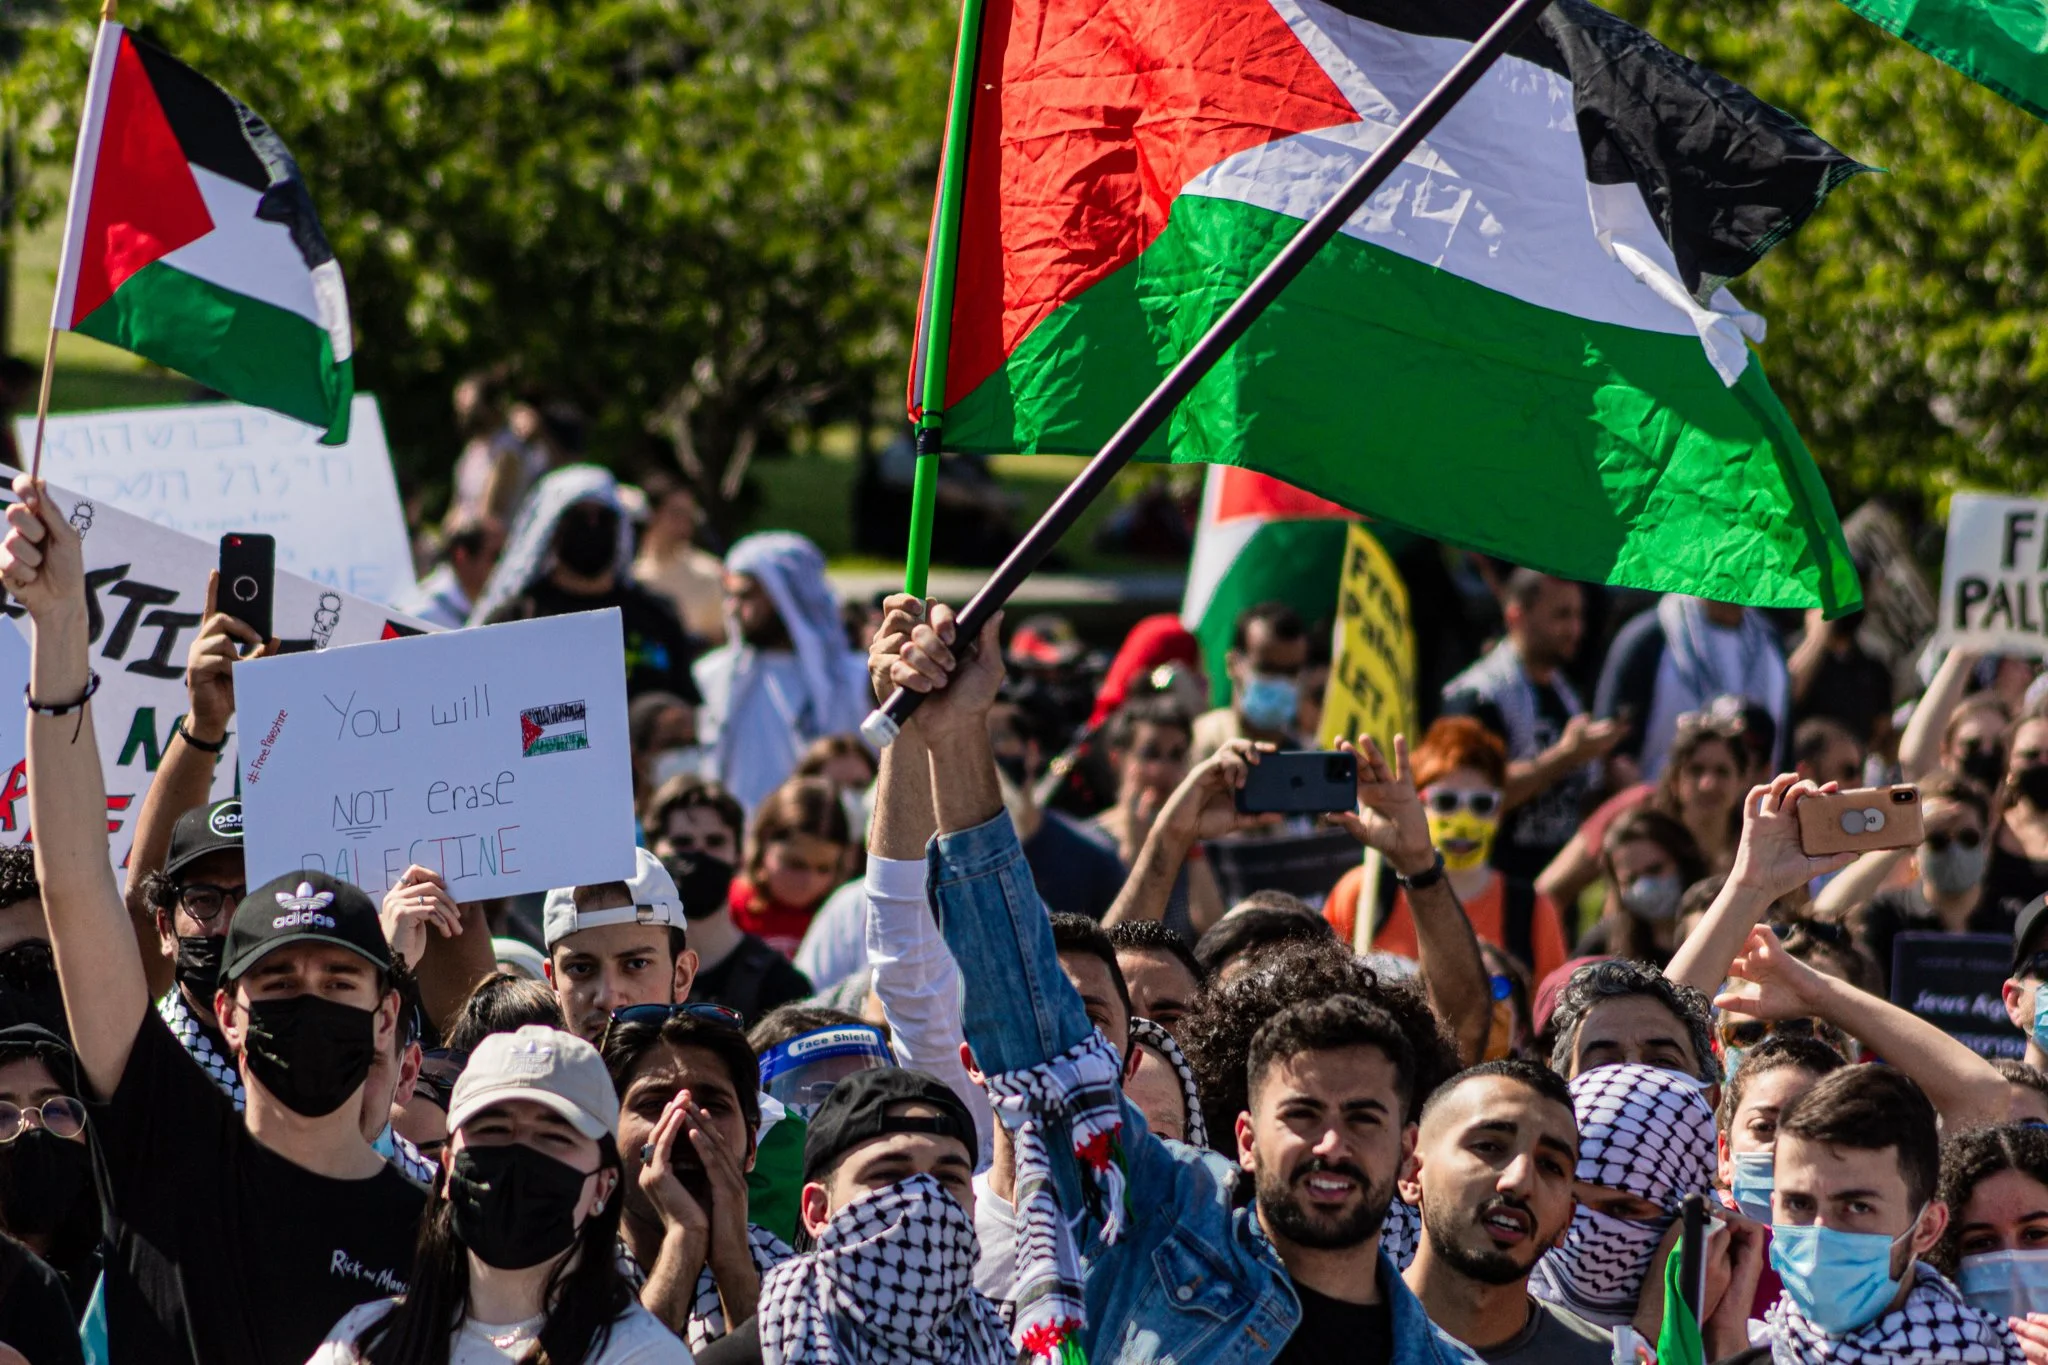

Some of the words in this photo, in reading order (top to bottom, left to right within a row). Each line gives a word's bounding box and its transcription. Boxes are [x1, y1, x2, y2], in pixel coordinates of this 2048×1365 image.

[2001, 510, 2048, 570] F
[323, 690, 401, 740] You
[431, 683, 490, 726] will
[332, 788, 394, 828] NOT
[427, 770, 515, 814] erase
[272, 910, 336, 929] adidas
[797, 1037, 829, 1052] Face
[833, 1033, 872, 1043] Shield
[330, 1248, 363, 1280] Rick
